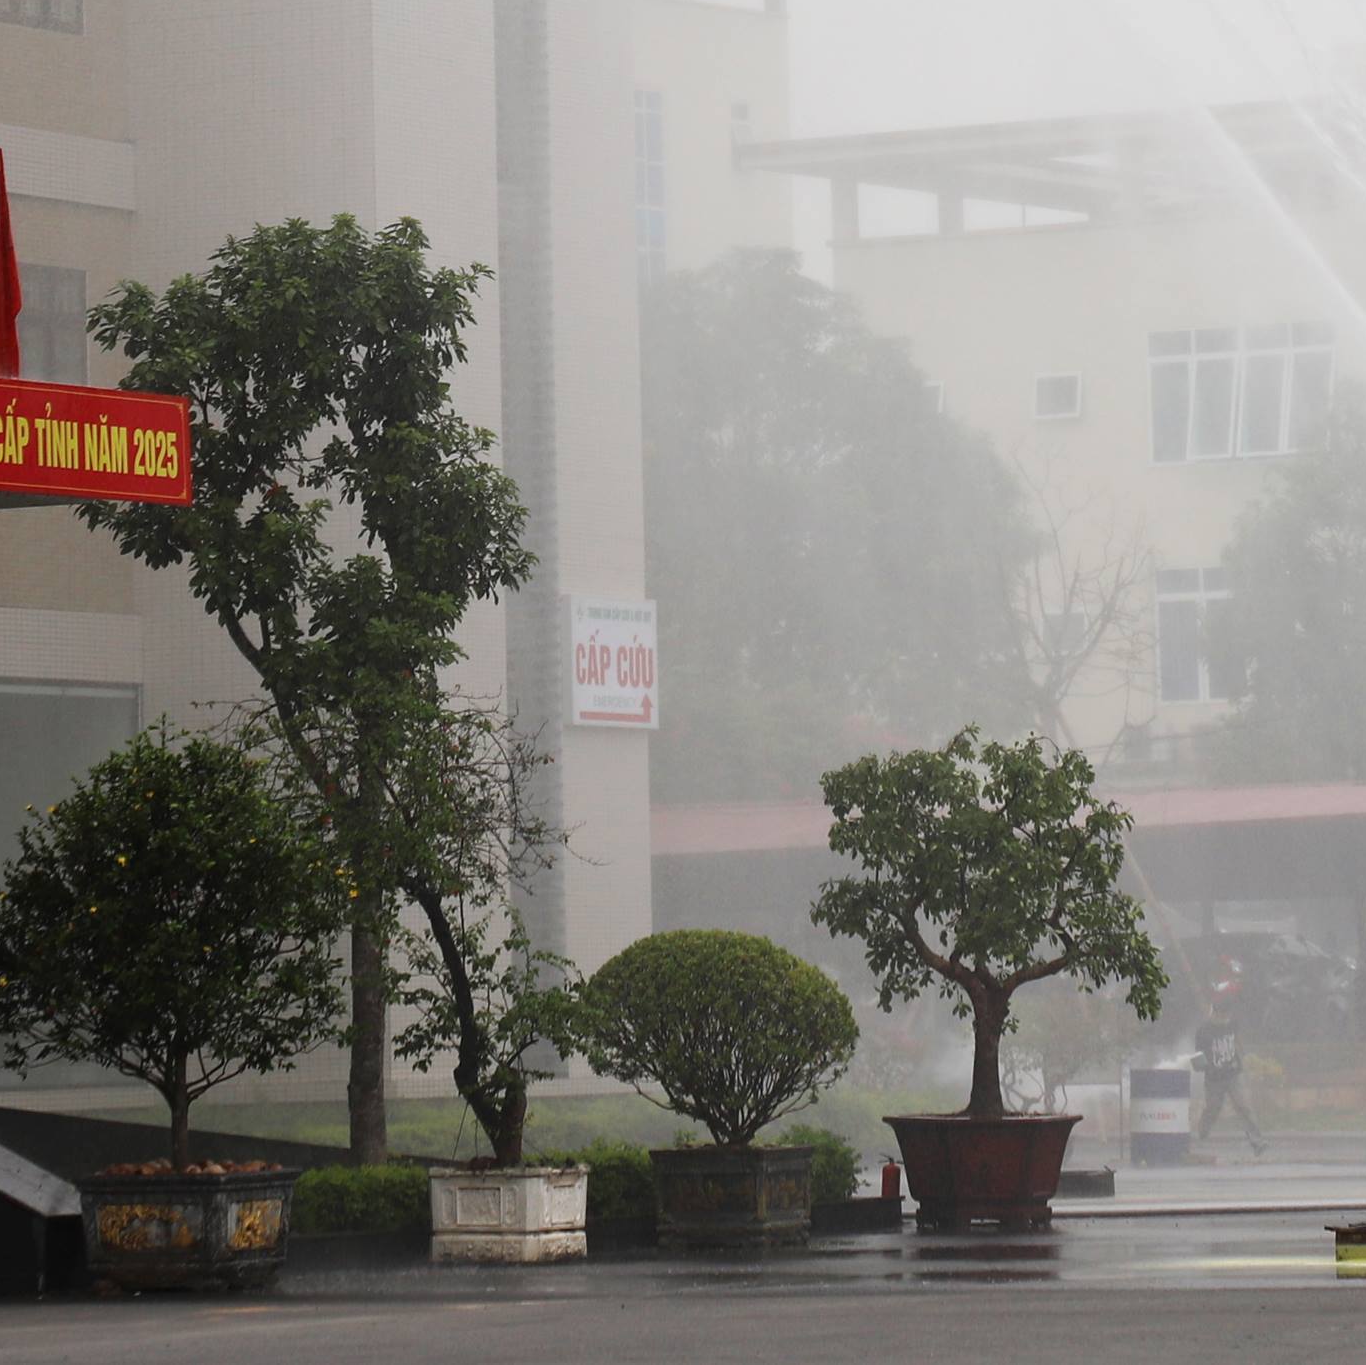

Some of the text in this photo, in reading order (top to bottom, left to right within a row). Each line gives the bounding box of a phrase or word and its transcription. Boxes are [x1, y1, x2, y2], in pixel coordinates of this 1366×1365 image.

[34, 403, 80, 470] TỈNH
[84, 416, 130, 475] NĂM
[133, 429, 180, 480] 2025
[576, 628, 654, 688] CẤP CỨU
